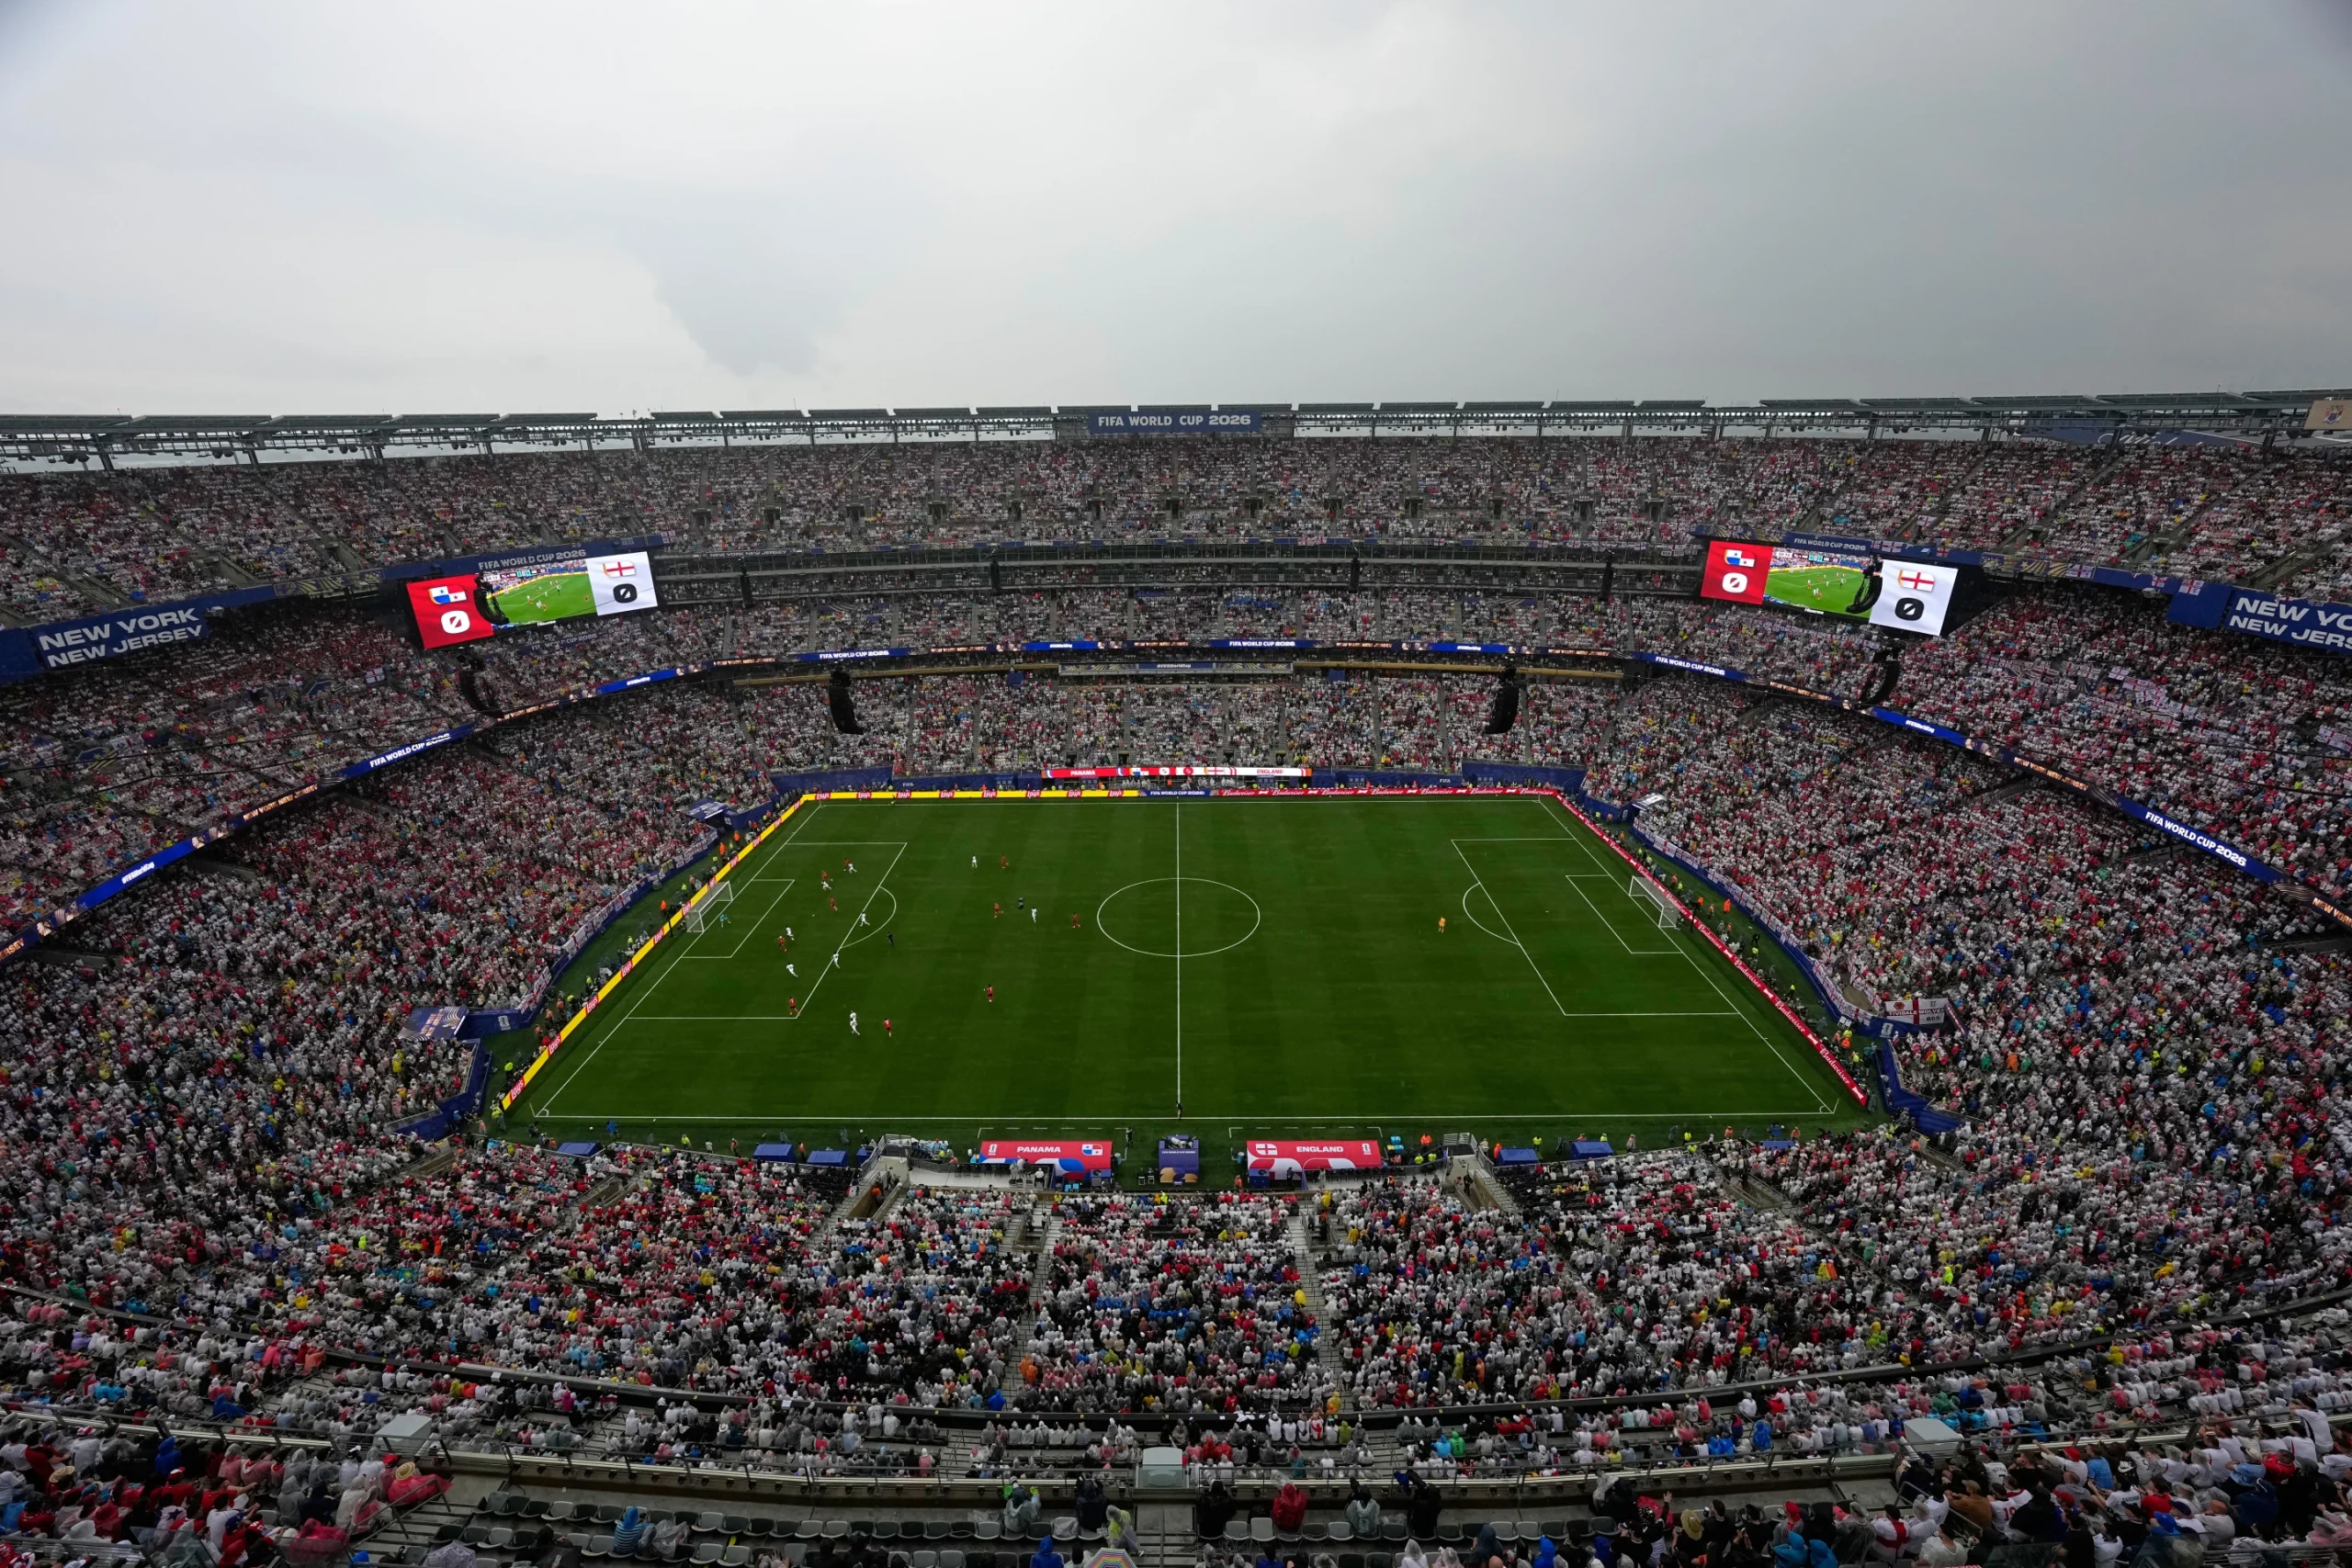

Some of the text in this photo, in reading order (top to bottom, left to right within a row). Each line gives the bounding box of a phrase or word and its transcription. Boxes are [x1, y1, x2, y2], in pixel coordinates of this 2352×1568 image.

[1098, 414, 1251, 427] FIFA WORLD CUP 2026
[1793, 537, 1866, 551] FIFA WORLD CUP 2026
[478, 559, 503, 571] FIFA
[503, 556, 537, 568] WORLD
[537, 552, 555, 564] CUP
[556, 549, 587, 560] 2026
[2235, 596, 2311, 623] NEW
[39, 607, 199, 650] NEW YORK
[2229, 615, 2289, 636] NEW
[47, 625, 202, 668] NEW JERSEY
[1655, 656, 1725, 676] FIFA WORLD CUP 2026
[369, 733, 452, 768] FIFA WORLD CUP 2026
[1420, 787, 1453, 795] Budweiser
[2144, 811, 2247, 867] FIFA WORLD CUP 2026
[2312, 897, 2334, 914] NEW
[1734, 956, 1761, 988] Budweiser
[1774, 997, 1806, 1033] Budweiser
[1819, 1043, 1850, 1085] Budweiser
[1017, 1145, 1061, 1154] PANAMA
